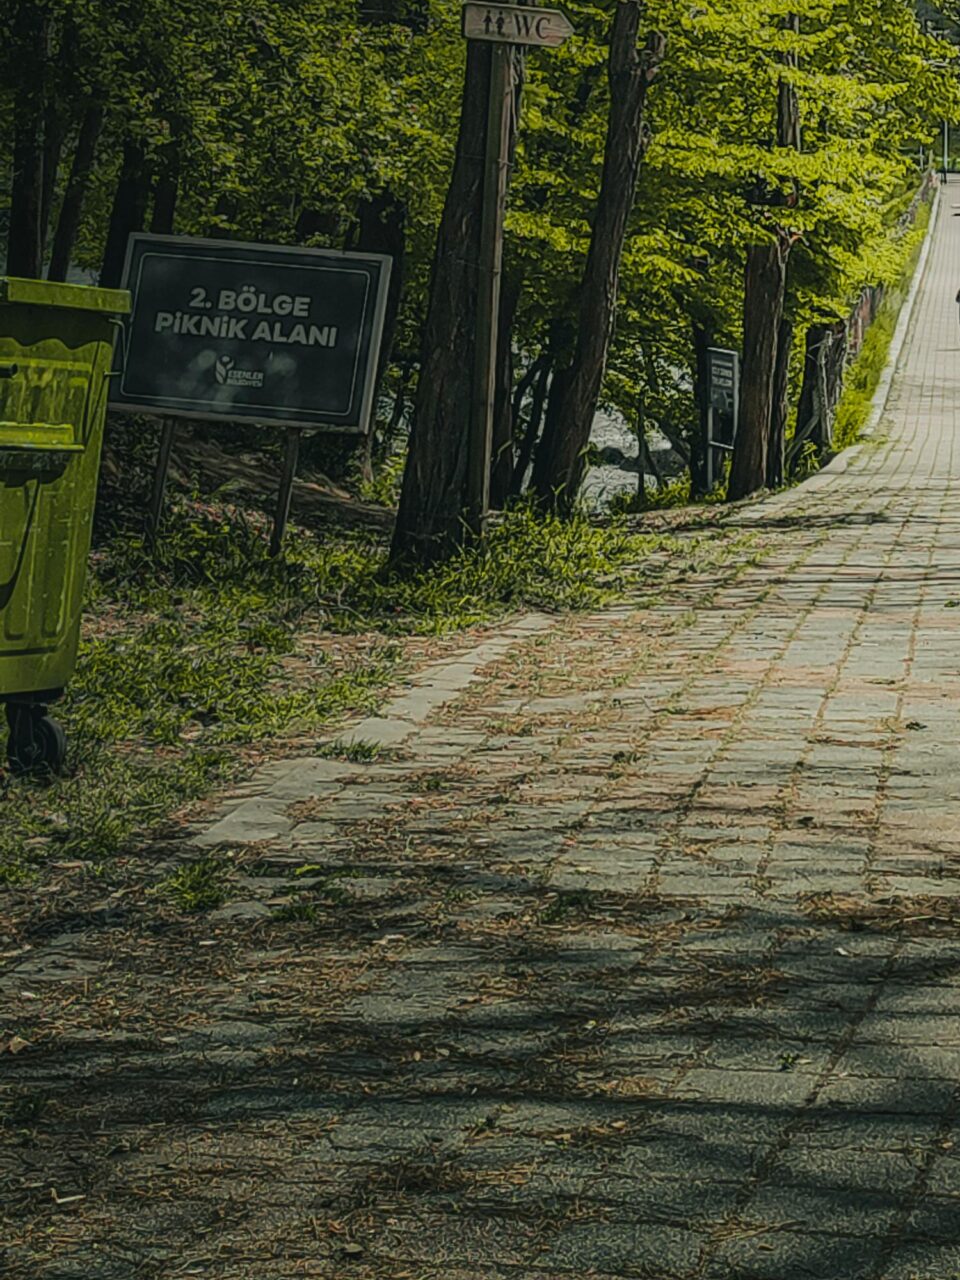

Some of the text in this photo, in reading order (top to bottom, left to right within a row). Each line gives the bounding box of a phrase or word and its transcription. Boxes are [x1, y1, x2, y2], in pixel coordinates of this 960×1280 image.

[513, 13, 551, 39] WC
[189, 286, 311, 317] 2. BÖLGE
[251, 321, 338, 348] ALANI
